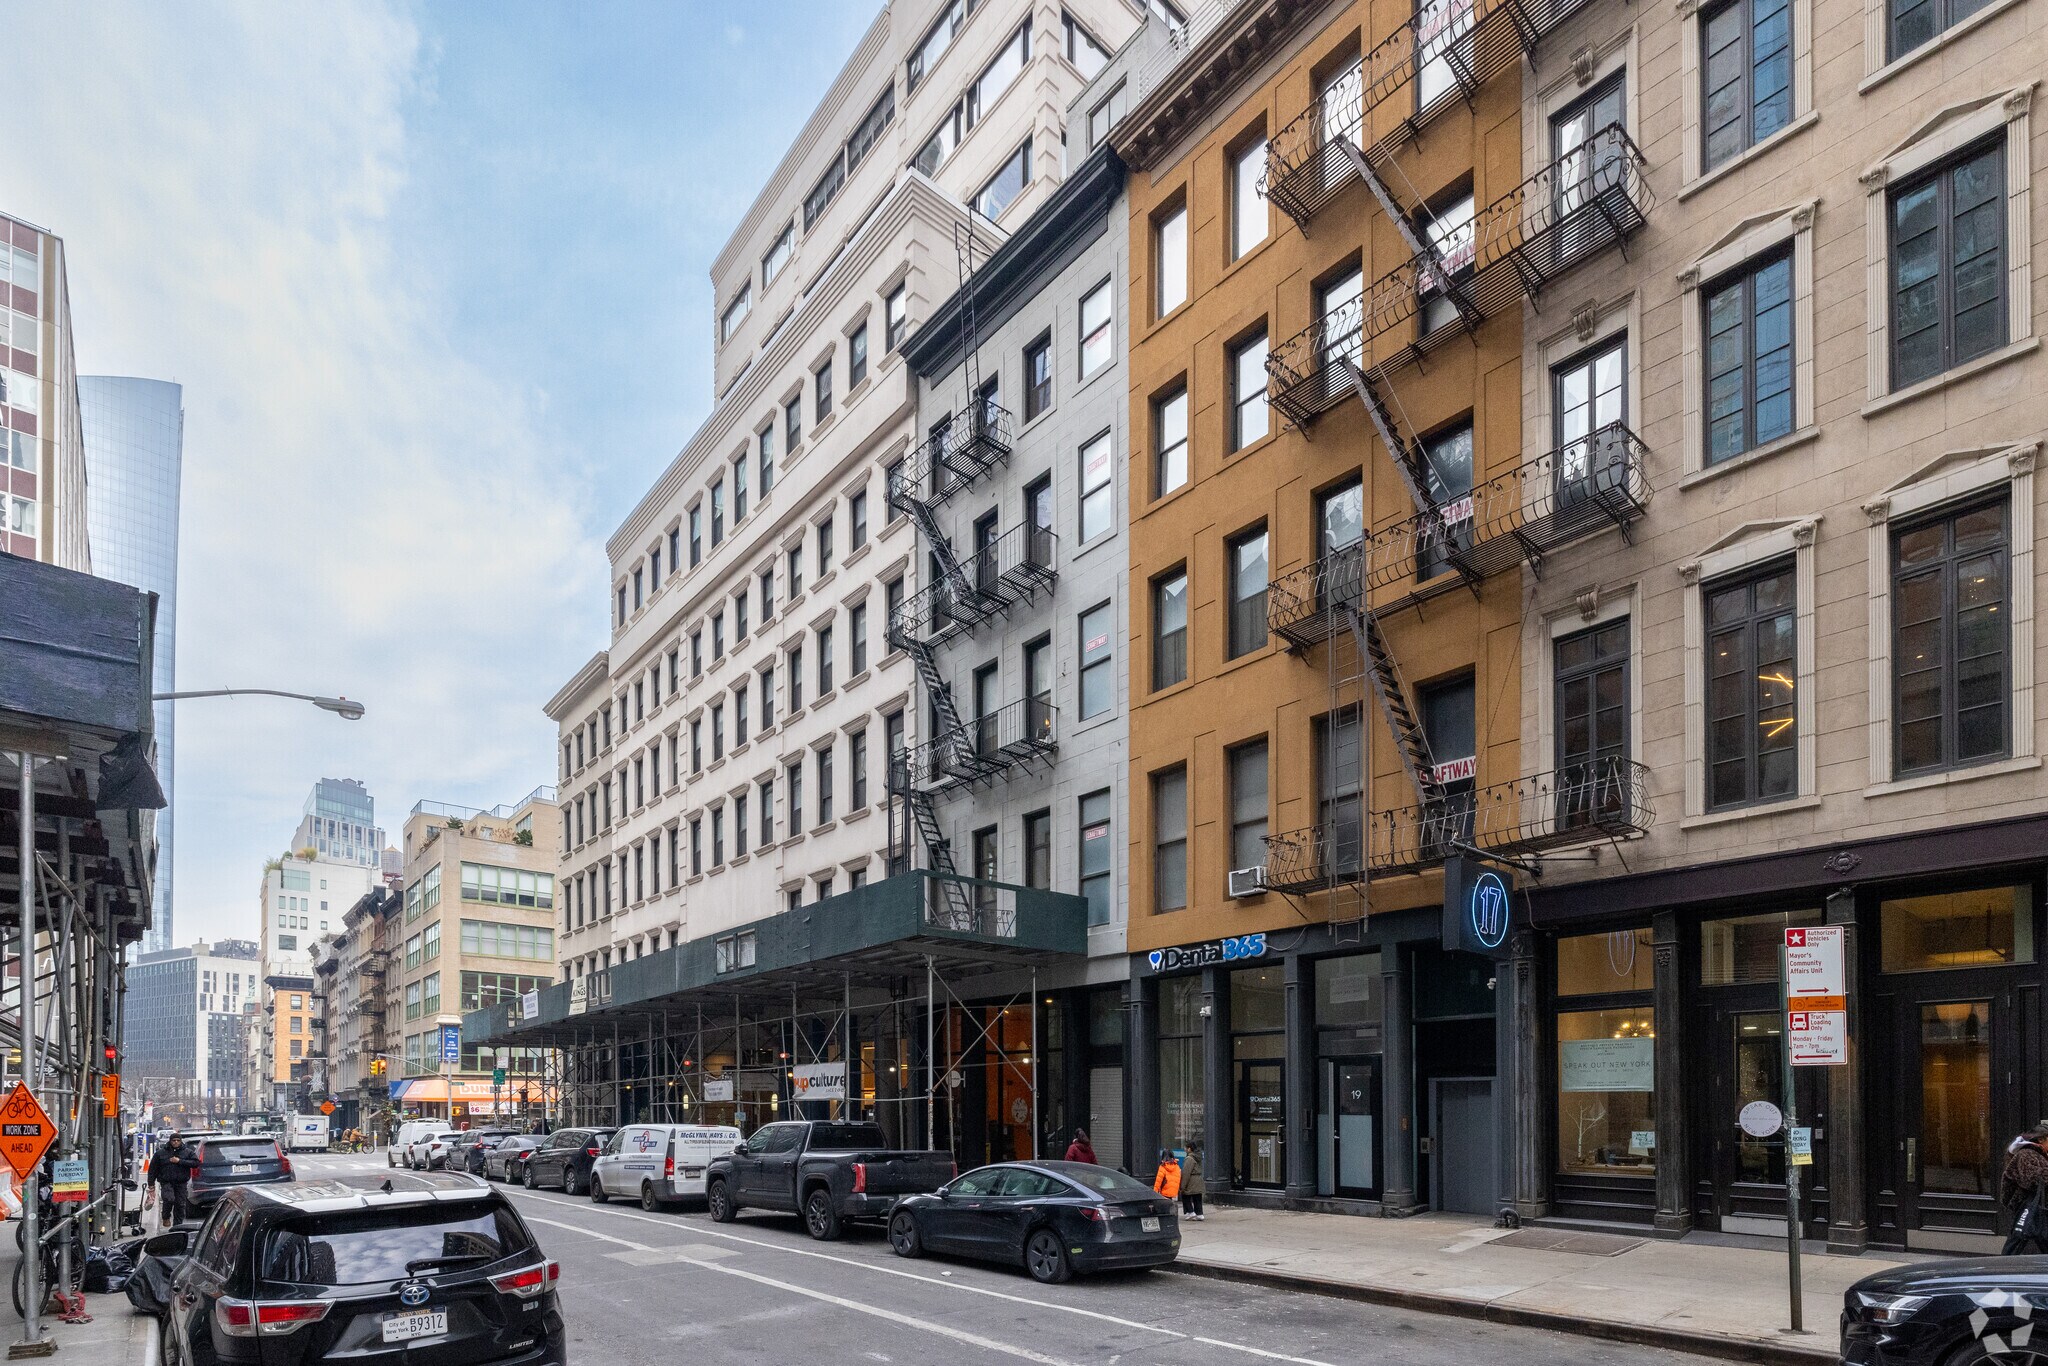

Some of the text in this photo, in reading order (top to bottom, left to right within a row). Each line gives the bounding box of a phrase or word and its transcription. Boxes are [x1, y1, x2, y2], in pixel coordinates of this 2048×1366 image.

[1420, 758, 1476, 784] SAFTWAY
[1480, 886, 1501, 934] 17
[1164, 932, 1267, 971] Dental365
[1351, 1090, 1361, 1099] 19
[1744, 1103, 1777, 1115] SPEAK OUT
[6, 1125, 39, 1135] WORK ZONE
[1744, 1124, 1777, 1135] NEW YORK
[11, 1143, 33, 1153] AHEAD
[509, 1340, 534, 1349] LIMITED
